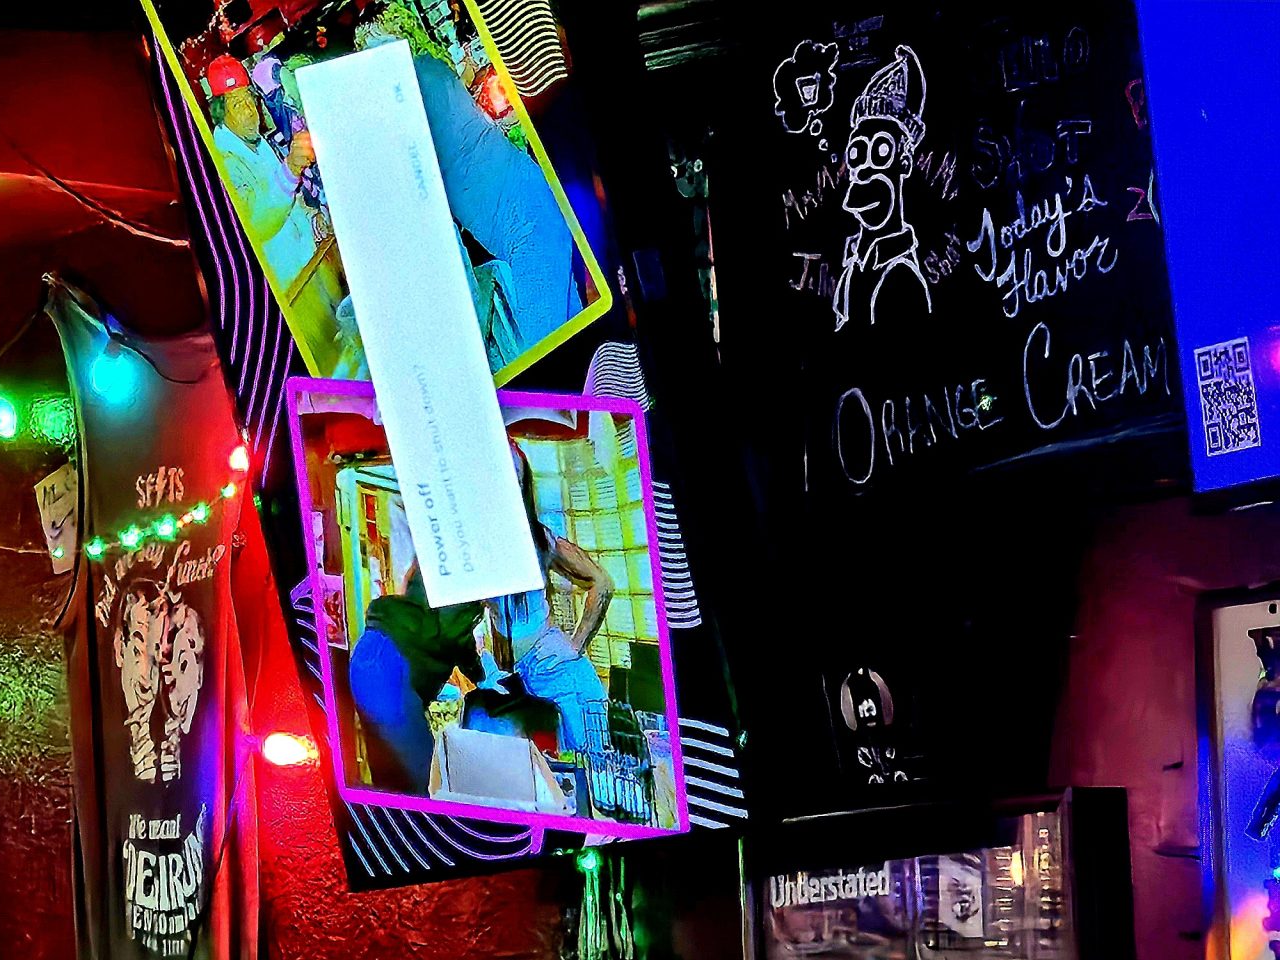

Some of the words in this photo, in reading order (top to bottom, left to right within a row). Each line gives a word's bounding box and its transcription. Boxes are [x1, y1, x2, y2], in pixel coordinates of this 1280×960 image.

[393, 81, 405, 104] OK
[966, 174, 1109, 283] Today's
[996, 236, 1119, 319] Flavor
[836, 378, 1005, 485] ORANGE
[1023, 321, 1172, 430] CREAM
[427, 417, 445, 454] shut
[416, 481, 435, 511] off
[442, 477, 460, 517] want
[427, 513, 452, 578] Power
[769, 860, 891, 908] Understated
